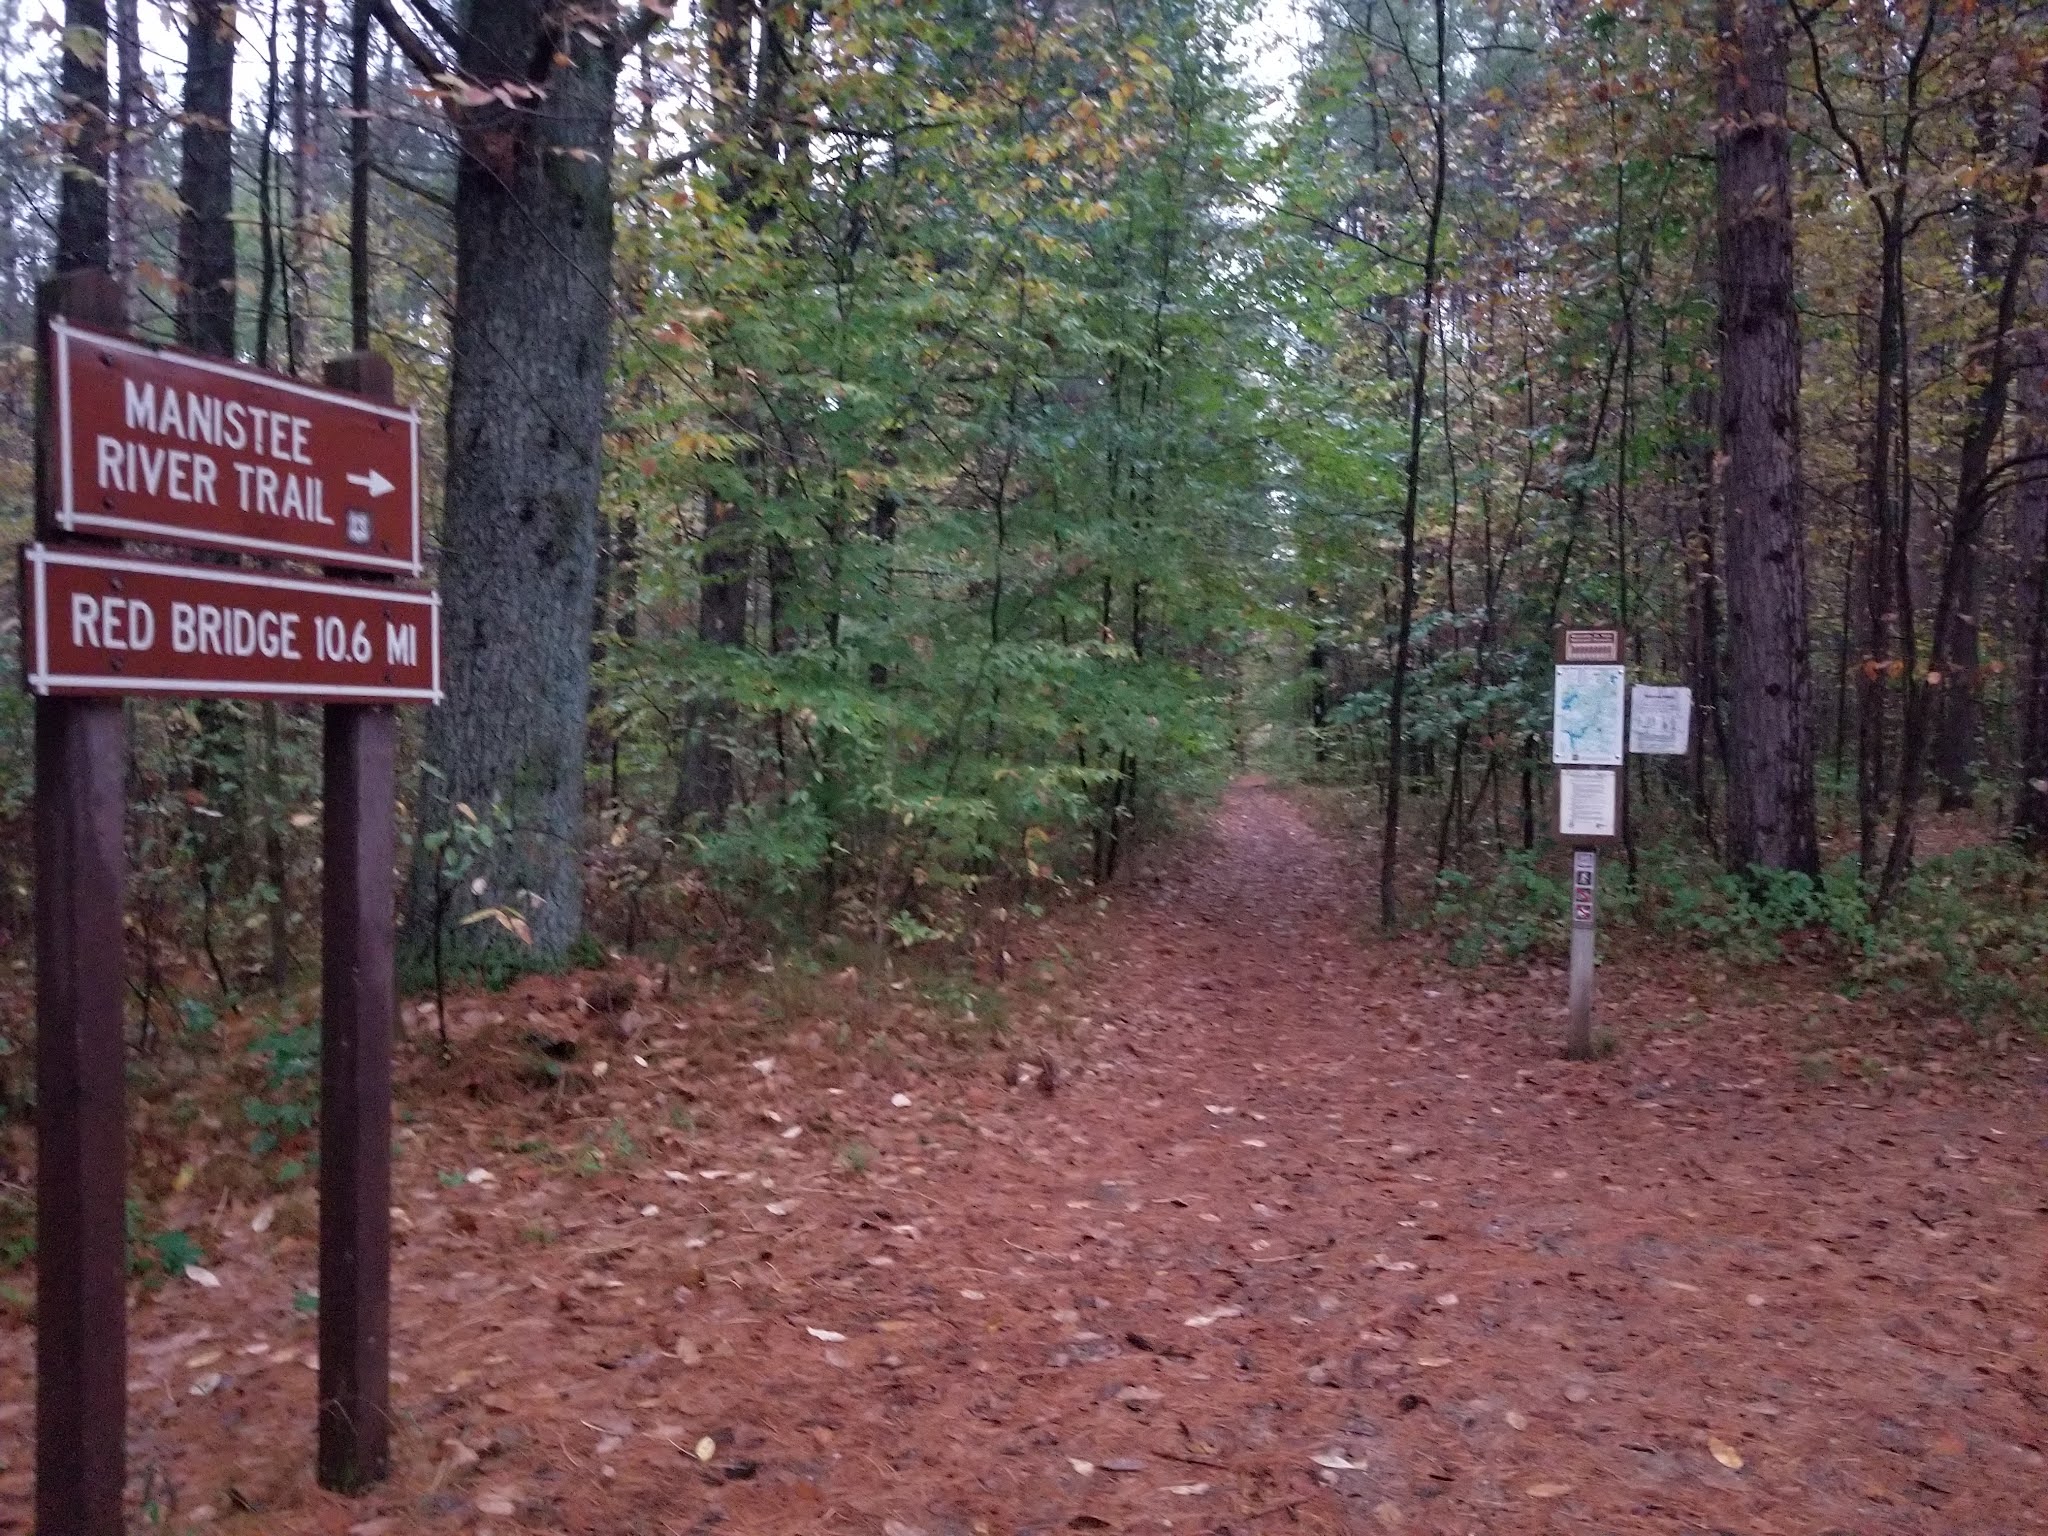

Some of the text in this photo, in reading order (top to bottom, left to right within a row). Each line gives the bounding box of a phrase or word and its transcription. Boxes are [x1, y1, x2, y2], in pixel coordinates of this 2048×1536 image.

[124, 380, 313, 465] MANISTEE
[97, 435, 335, 526] RIVER TRAIL
[71, 593, 418, 667] RED BRIDGE 10.6 MI
